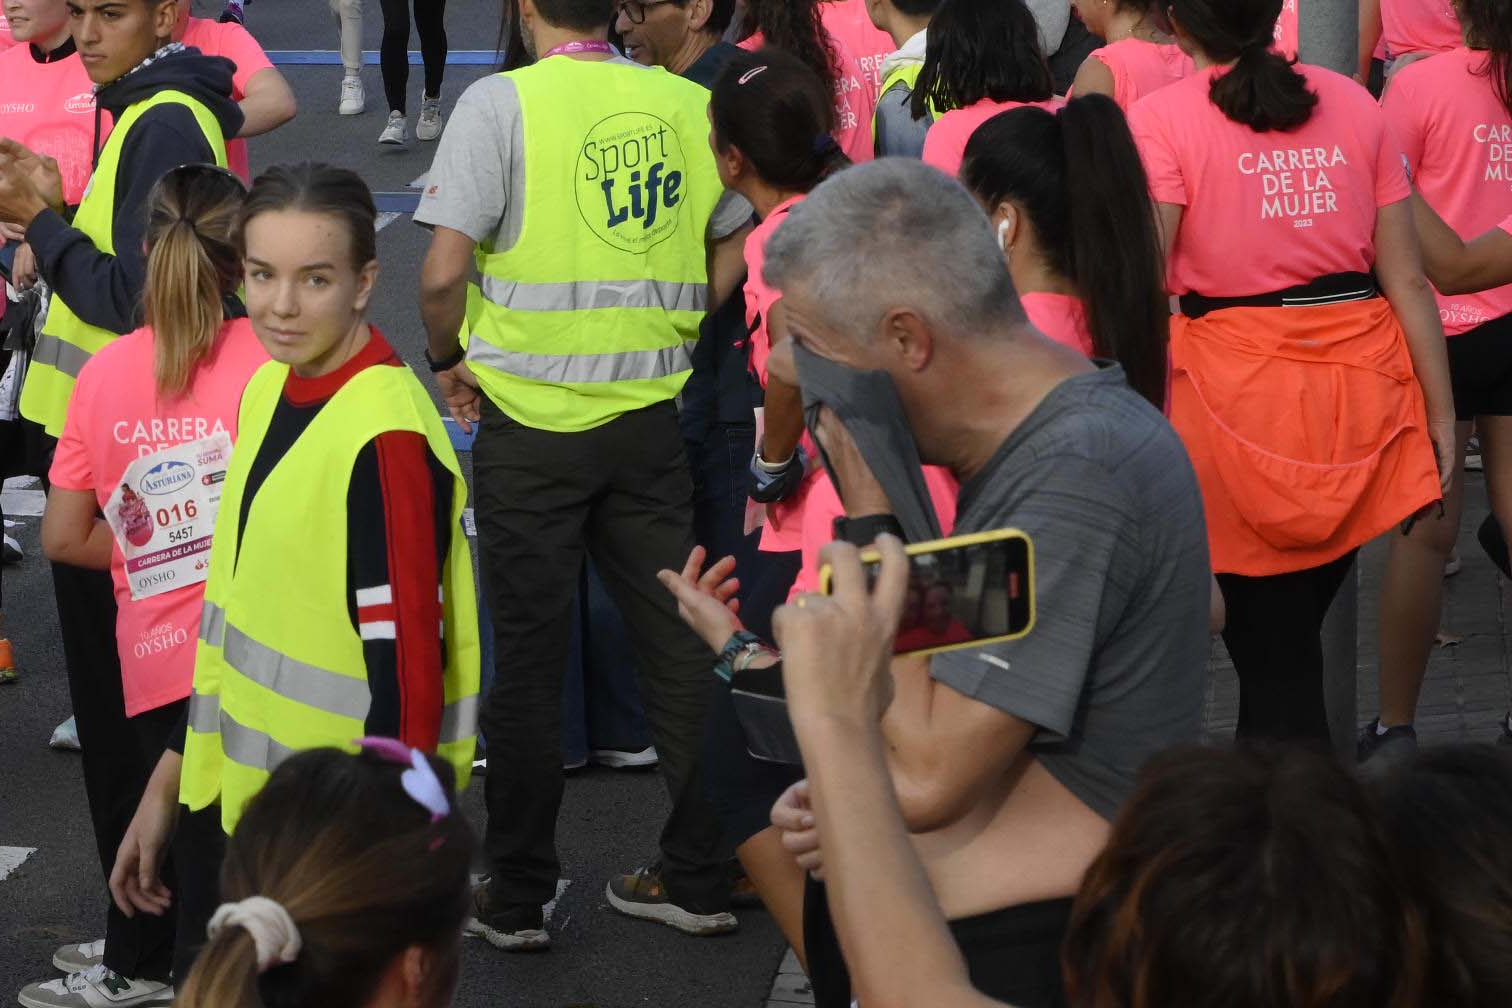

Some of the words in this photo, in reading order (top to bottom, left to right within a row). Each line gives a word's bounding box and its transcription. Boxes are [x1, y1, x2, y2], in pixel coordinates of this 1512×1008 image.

[0, 102, 35, 114] OYSHO
[584, 124, 669, 182] Sport
[1238, 144, 1348, 176] CARRERA
[600, 161, 682, 230] Life
[1262, 170, 1294, 196] DE
[1302, 168, 1333, 192] LA
[1261, 192, 1339, 220] MUJER
[1293, 218, 1314, 229] 2023
[113, 417, 226, 444] CARRERA
[197, 454, 224, 467] SUMA
[142, 470, 192, 492] ASTURIANA
[156, 498, 198, 527] 016
[168, 525, 194, 543] 5457
[138, 551, 171, 568] CARRERA
[171, 548, 182, 558] DE
[183, 545, 193, 555] LA
[193, 538, 213, 551] MUJE
[138, 569, 176, 589] OYSHO
[134, 627, 188, 660] OYSHO
